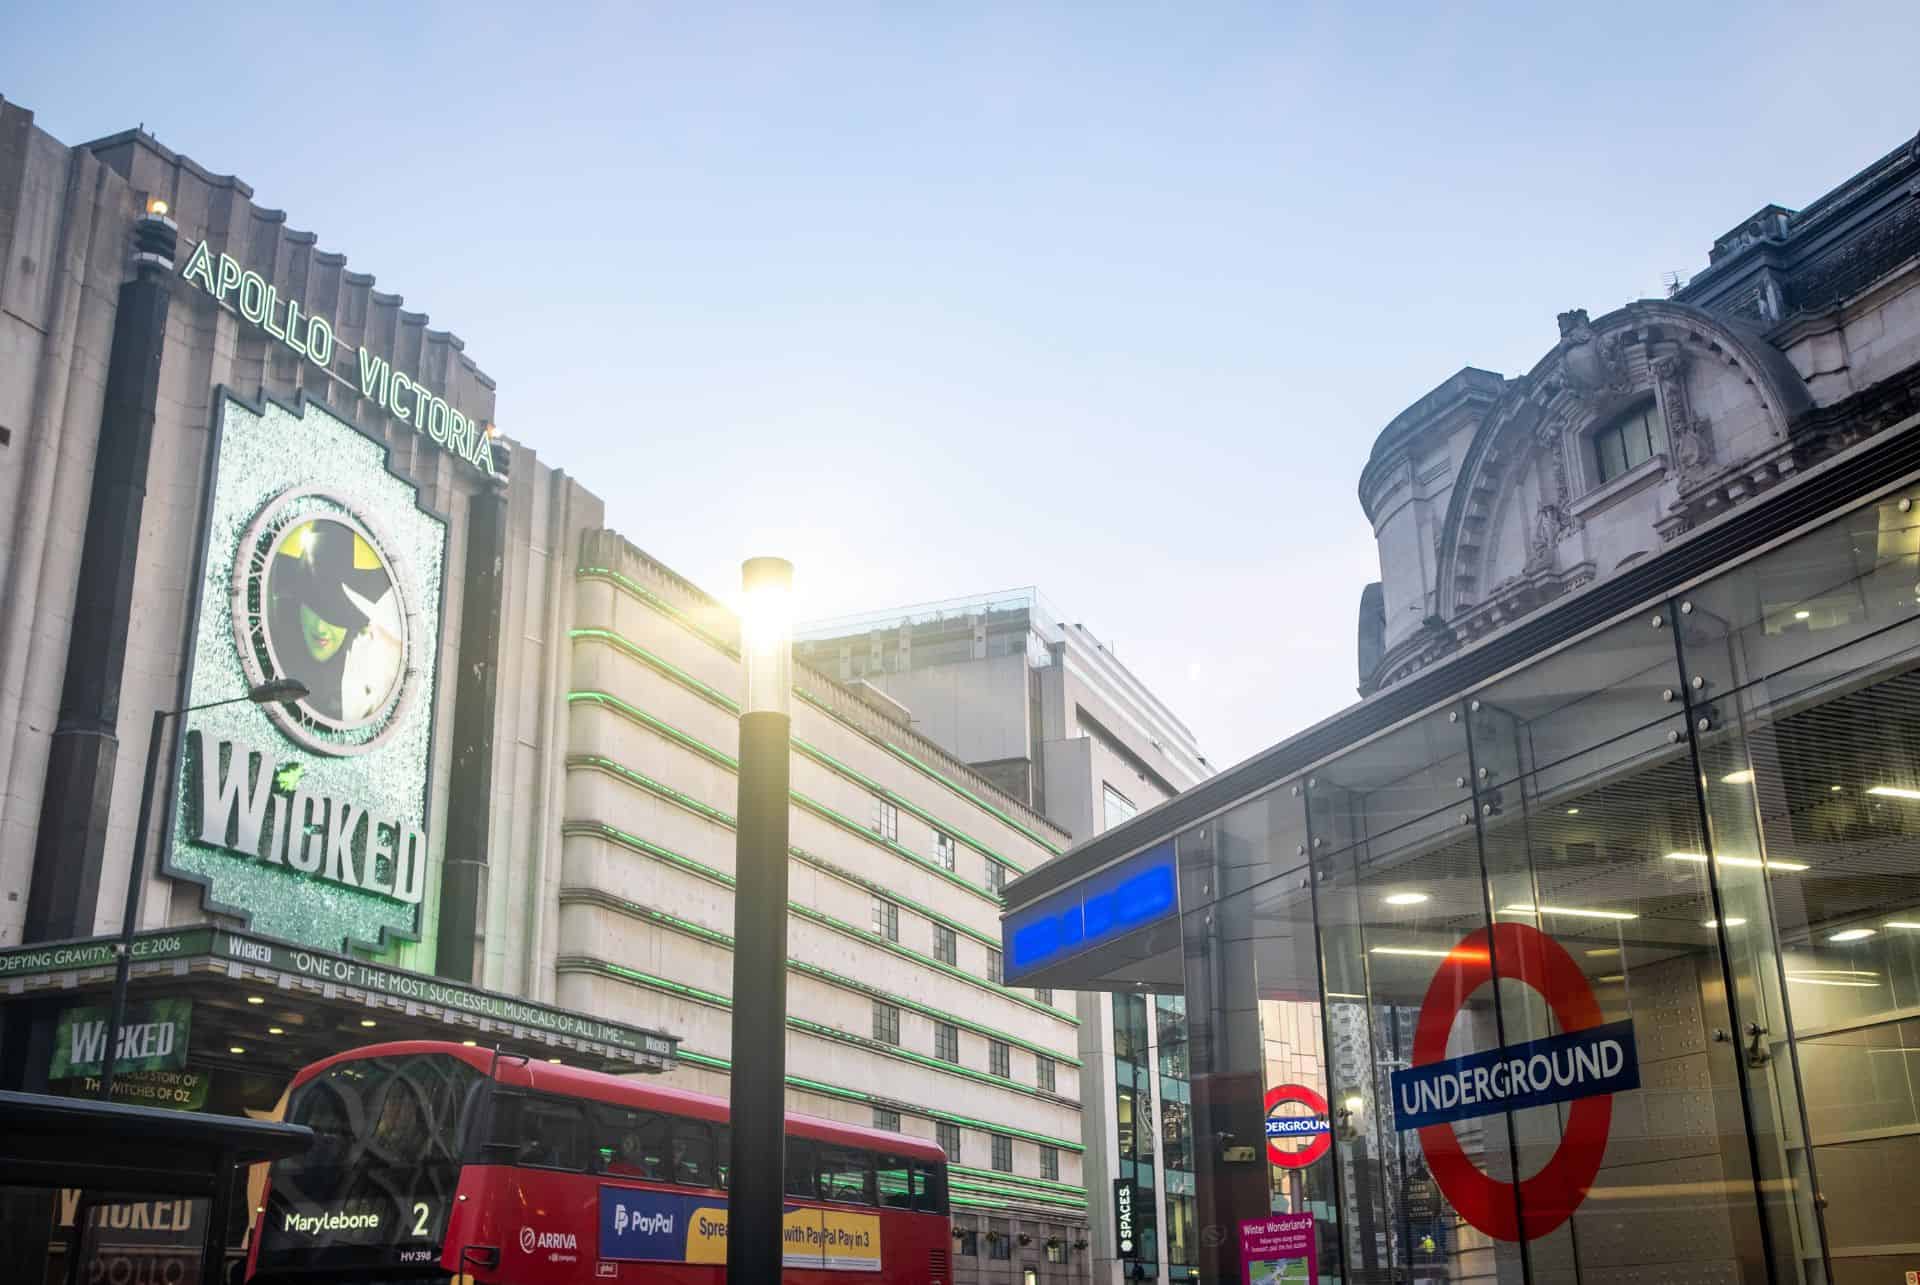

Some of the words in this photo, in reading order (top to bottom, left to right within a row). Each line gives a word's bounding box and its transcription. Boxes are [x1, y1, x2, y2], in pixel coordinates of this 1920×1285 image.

[183, 240, 333, 367] APOLLO
[360, 347, 496, 475] VICTORIA
[0, 952, 50, 971] DEFYING
[54, 945, 108, 965] GRAVITY
[152, 937, 181, 954] 2006
[334, 962, 355, 981] OF
[359, 968, 385, 990] THE
[389, 974, 426, 997] MOST
[430, 985, 500, 1015] SUCCESSFUL
[504, 1003, 555, 1026] MUSICALS
[558, 1015, 574, 1032] OF
[575, 1019, 594, 1038] ALL
[151, 1072, 180, 1086] STORY
[183, 1074, 200, 1088] OF
[1401, 1039, 1624, 1115] UNDERGROUND
[85, 1077, 101, 1091] TH
[157, 1088, 171, 1100] OF
[173, 1090, 193, 1103] OZ
[285, 1211, 379, 1236] Marylebone
[412, 1202, 430, 1236] 2
[632, 1212, 673, 1236] PayPal
[1243, 1224, 1265, 1236] Winter
[1267, 1218, 1305, 1232] Wonderland
[537, 1232, 577, 1250] ARRIVA
[784, 1225, 805, 1243] with
[807, 1227, 836, 1248] PayPal
[838, 1229, 854, 1249] Pay
[855, 1231, 863, 1247] in
[863, 1232, 870, 1248] 3
